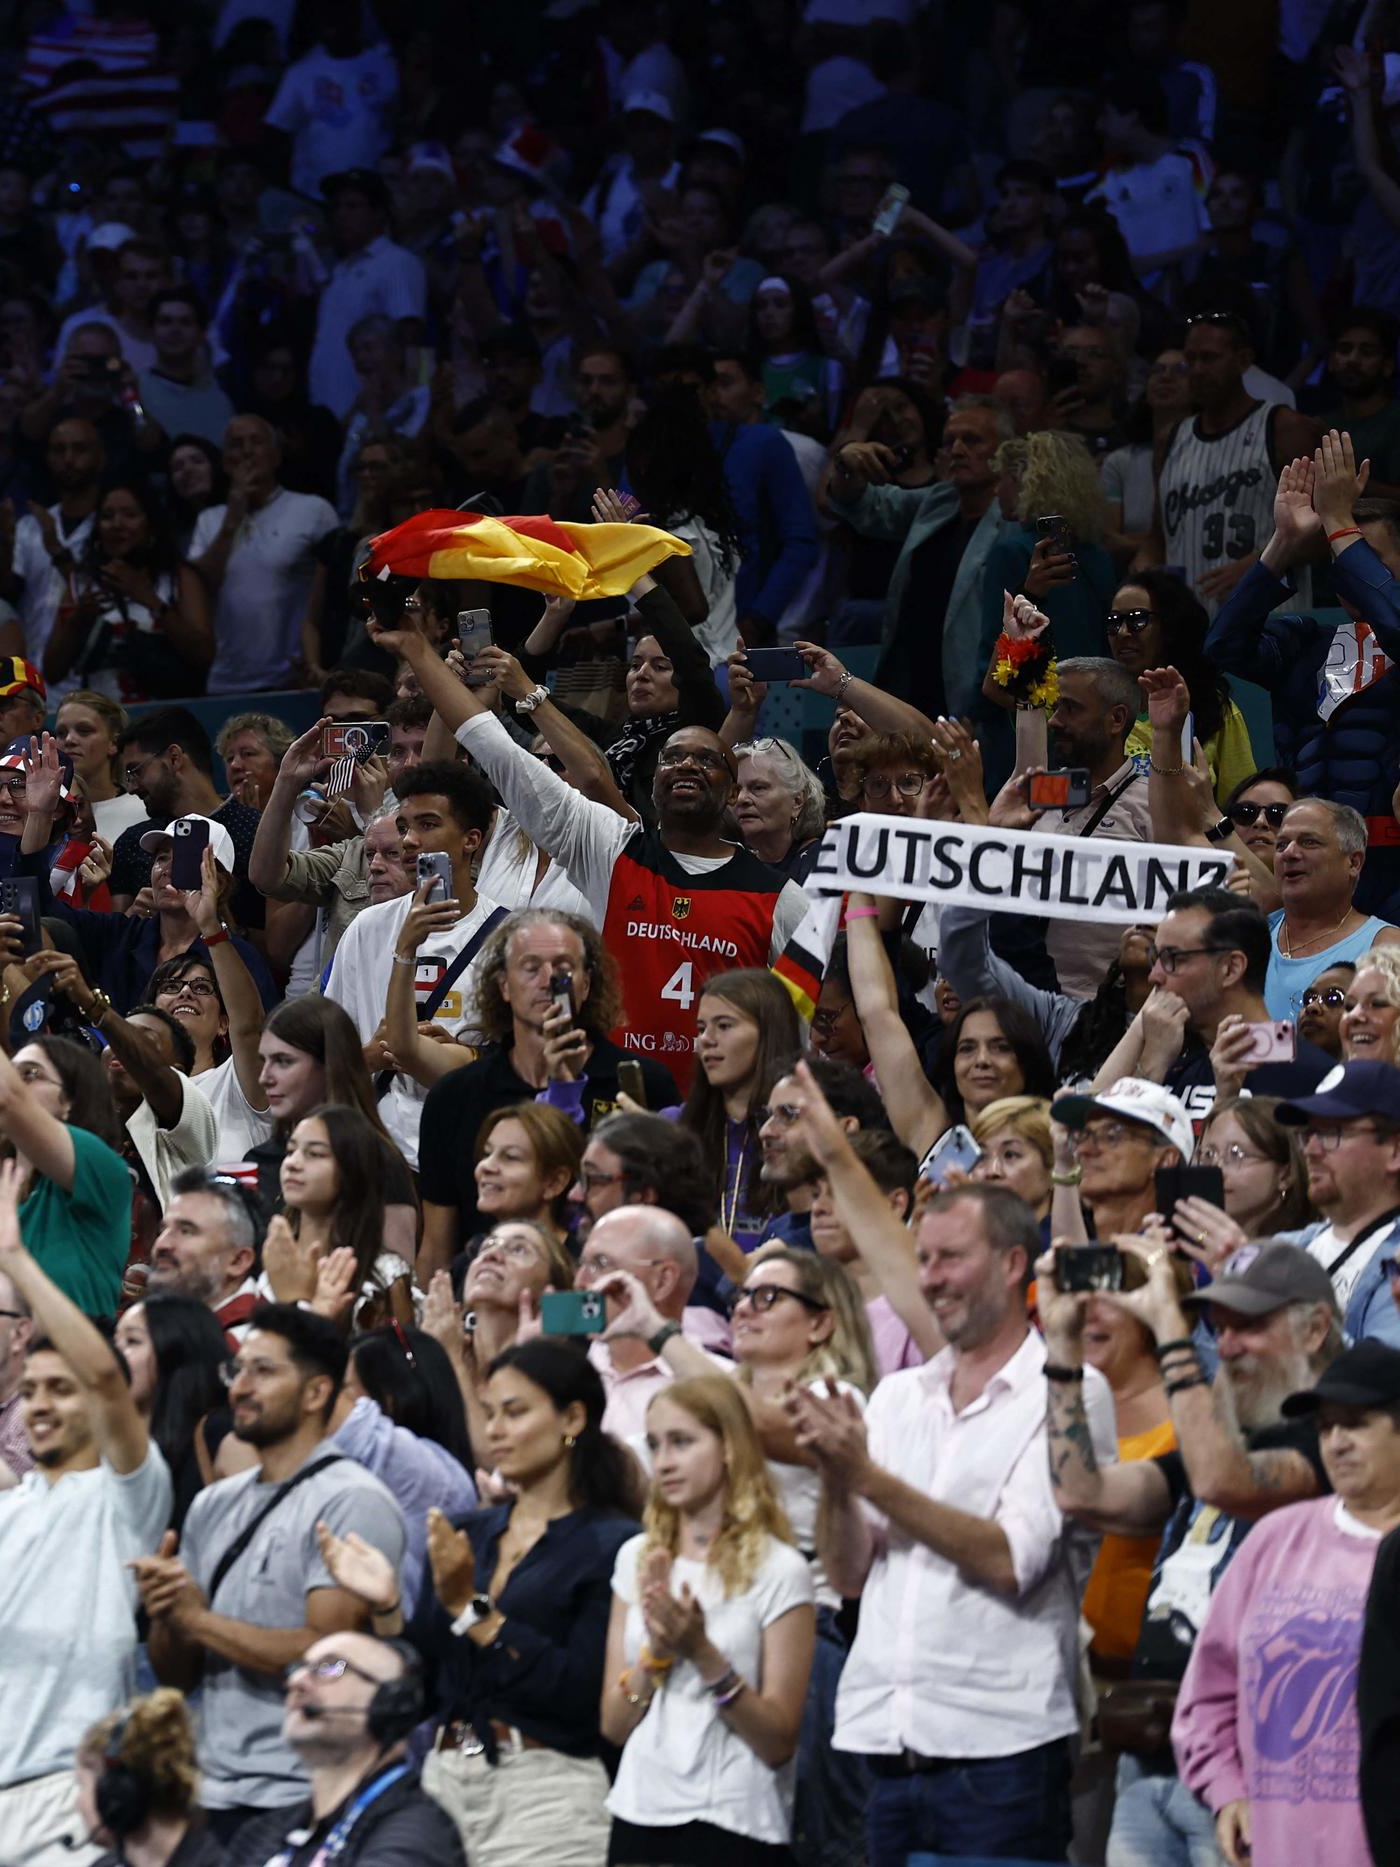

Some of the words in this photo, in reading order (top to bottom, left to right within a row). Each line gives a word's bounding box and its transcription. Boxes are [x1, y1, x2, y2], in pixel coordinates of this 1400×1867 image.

[1166, 467, 1263, 537] Chicago
[1202, 512, 1256, 560] 33
[627, 921, 738, 958] DEUTSCHLAND
[660, 961, 695, 1010] 4
[623, 1032, 657, 1051] ING
